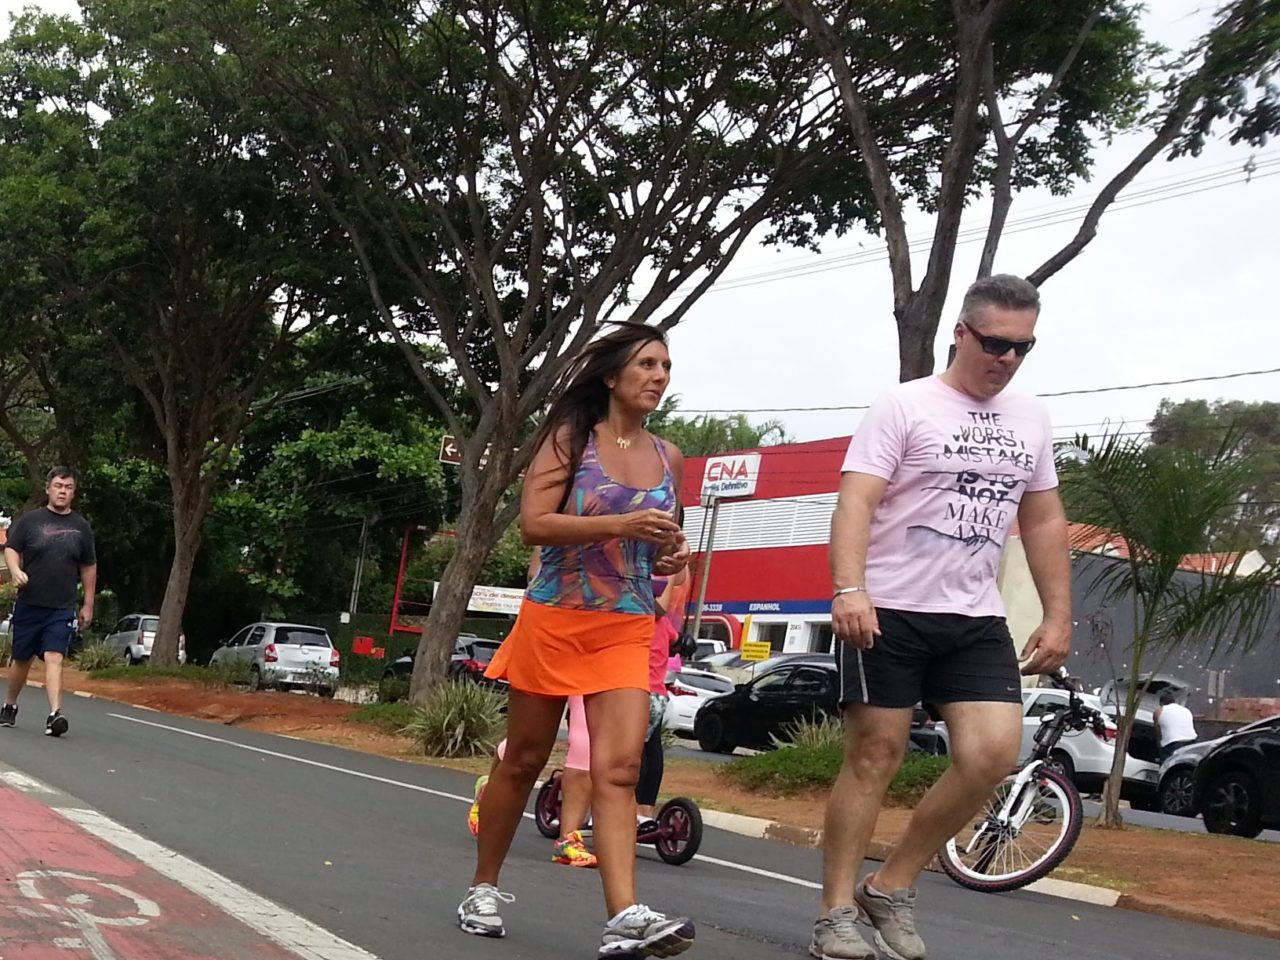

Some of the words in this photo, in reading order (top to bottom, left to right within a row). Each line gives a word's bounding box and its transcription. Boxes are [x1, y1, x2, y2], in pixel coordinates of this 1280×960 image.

[967, 411, 1002, 427] THE
[942, 443, 1034, 472] MISTAKE
[707, 459, 749, 482] CNA
[956, 468, 980, 484] IS
[987, 472, 1019, 490] TO
[721, 481, 749, 492] Definitivo
[958, 484, 1009, 508] NOT
[943, 502, 1008, 530] MAKE
[748, 602, 780, 611] ESPANHOL
